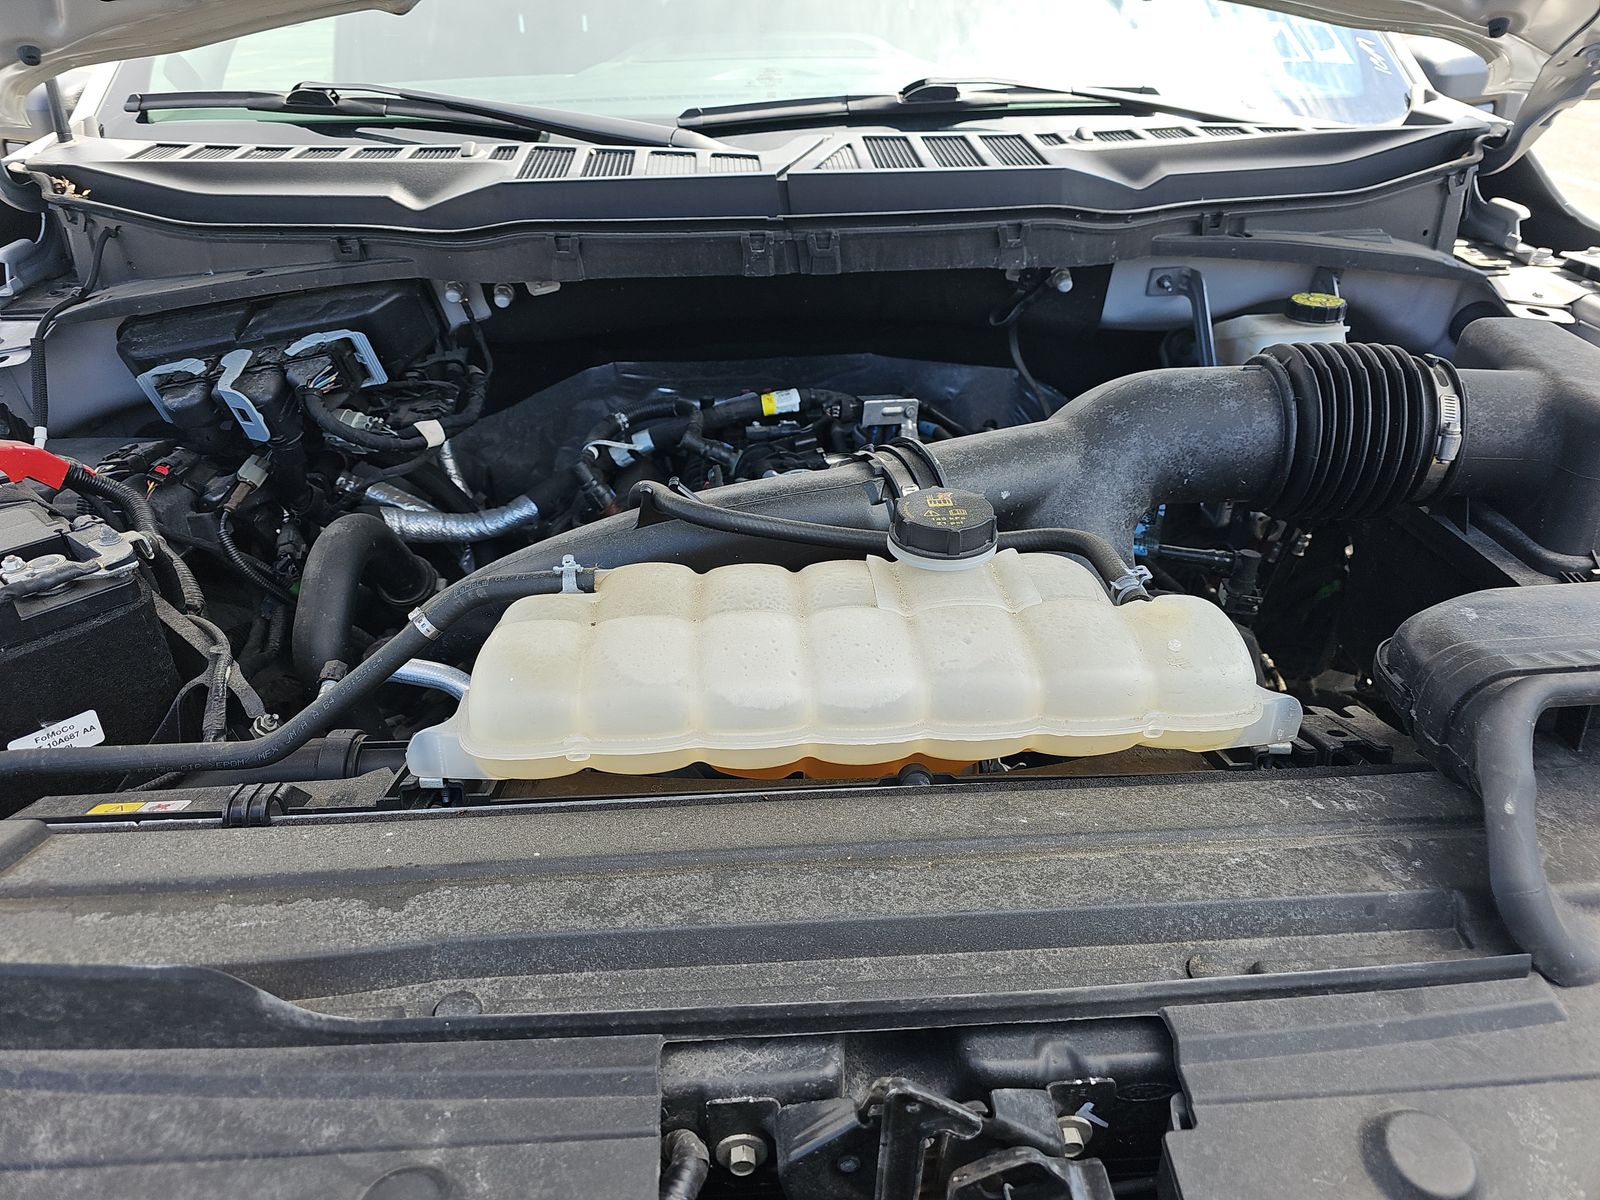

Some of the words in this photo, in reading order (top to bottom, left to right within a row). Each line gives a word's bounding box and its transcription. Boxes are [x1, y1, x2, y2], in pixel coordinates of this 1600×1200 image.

[34, 724, 75, 743] FoMoCo
[47, 730, 79, 748] 10A687
[83, 725, 96, 734] AA
